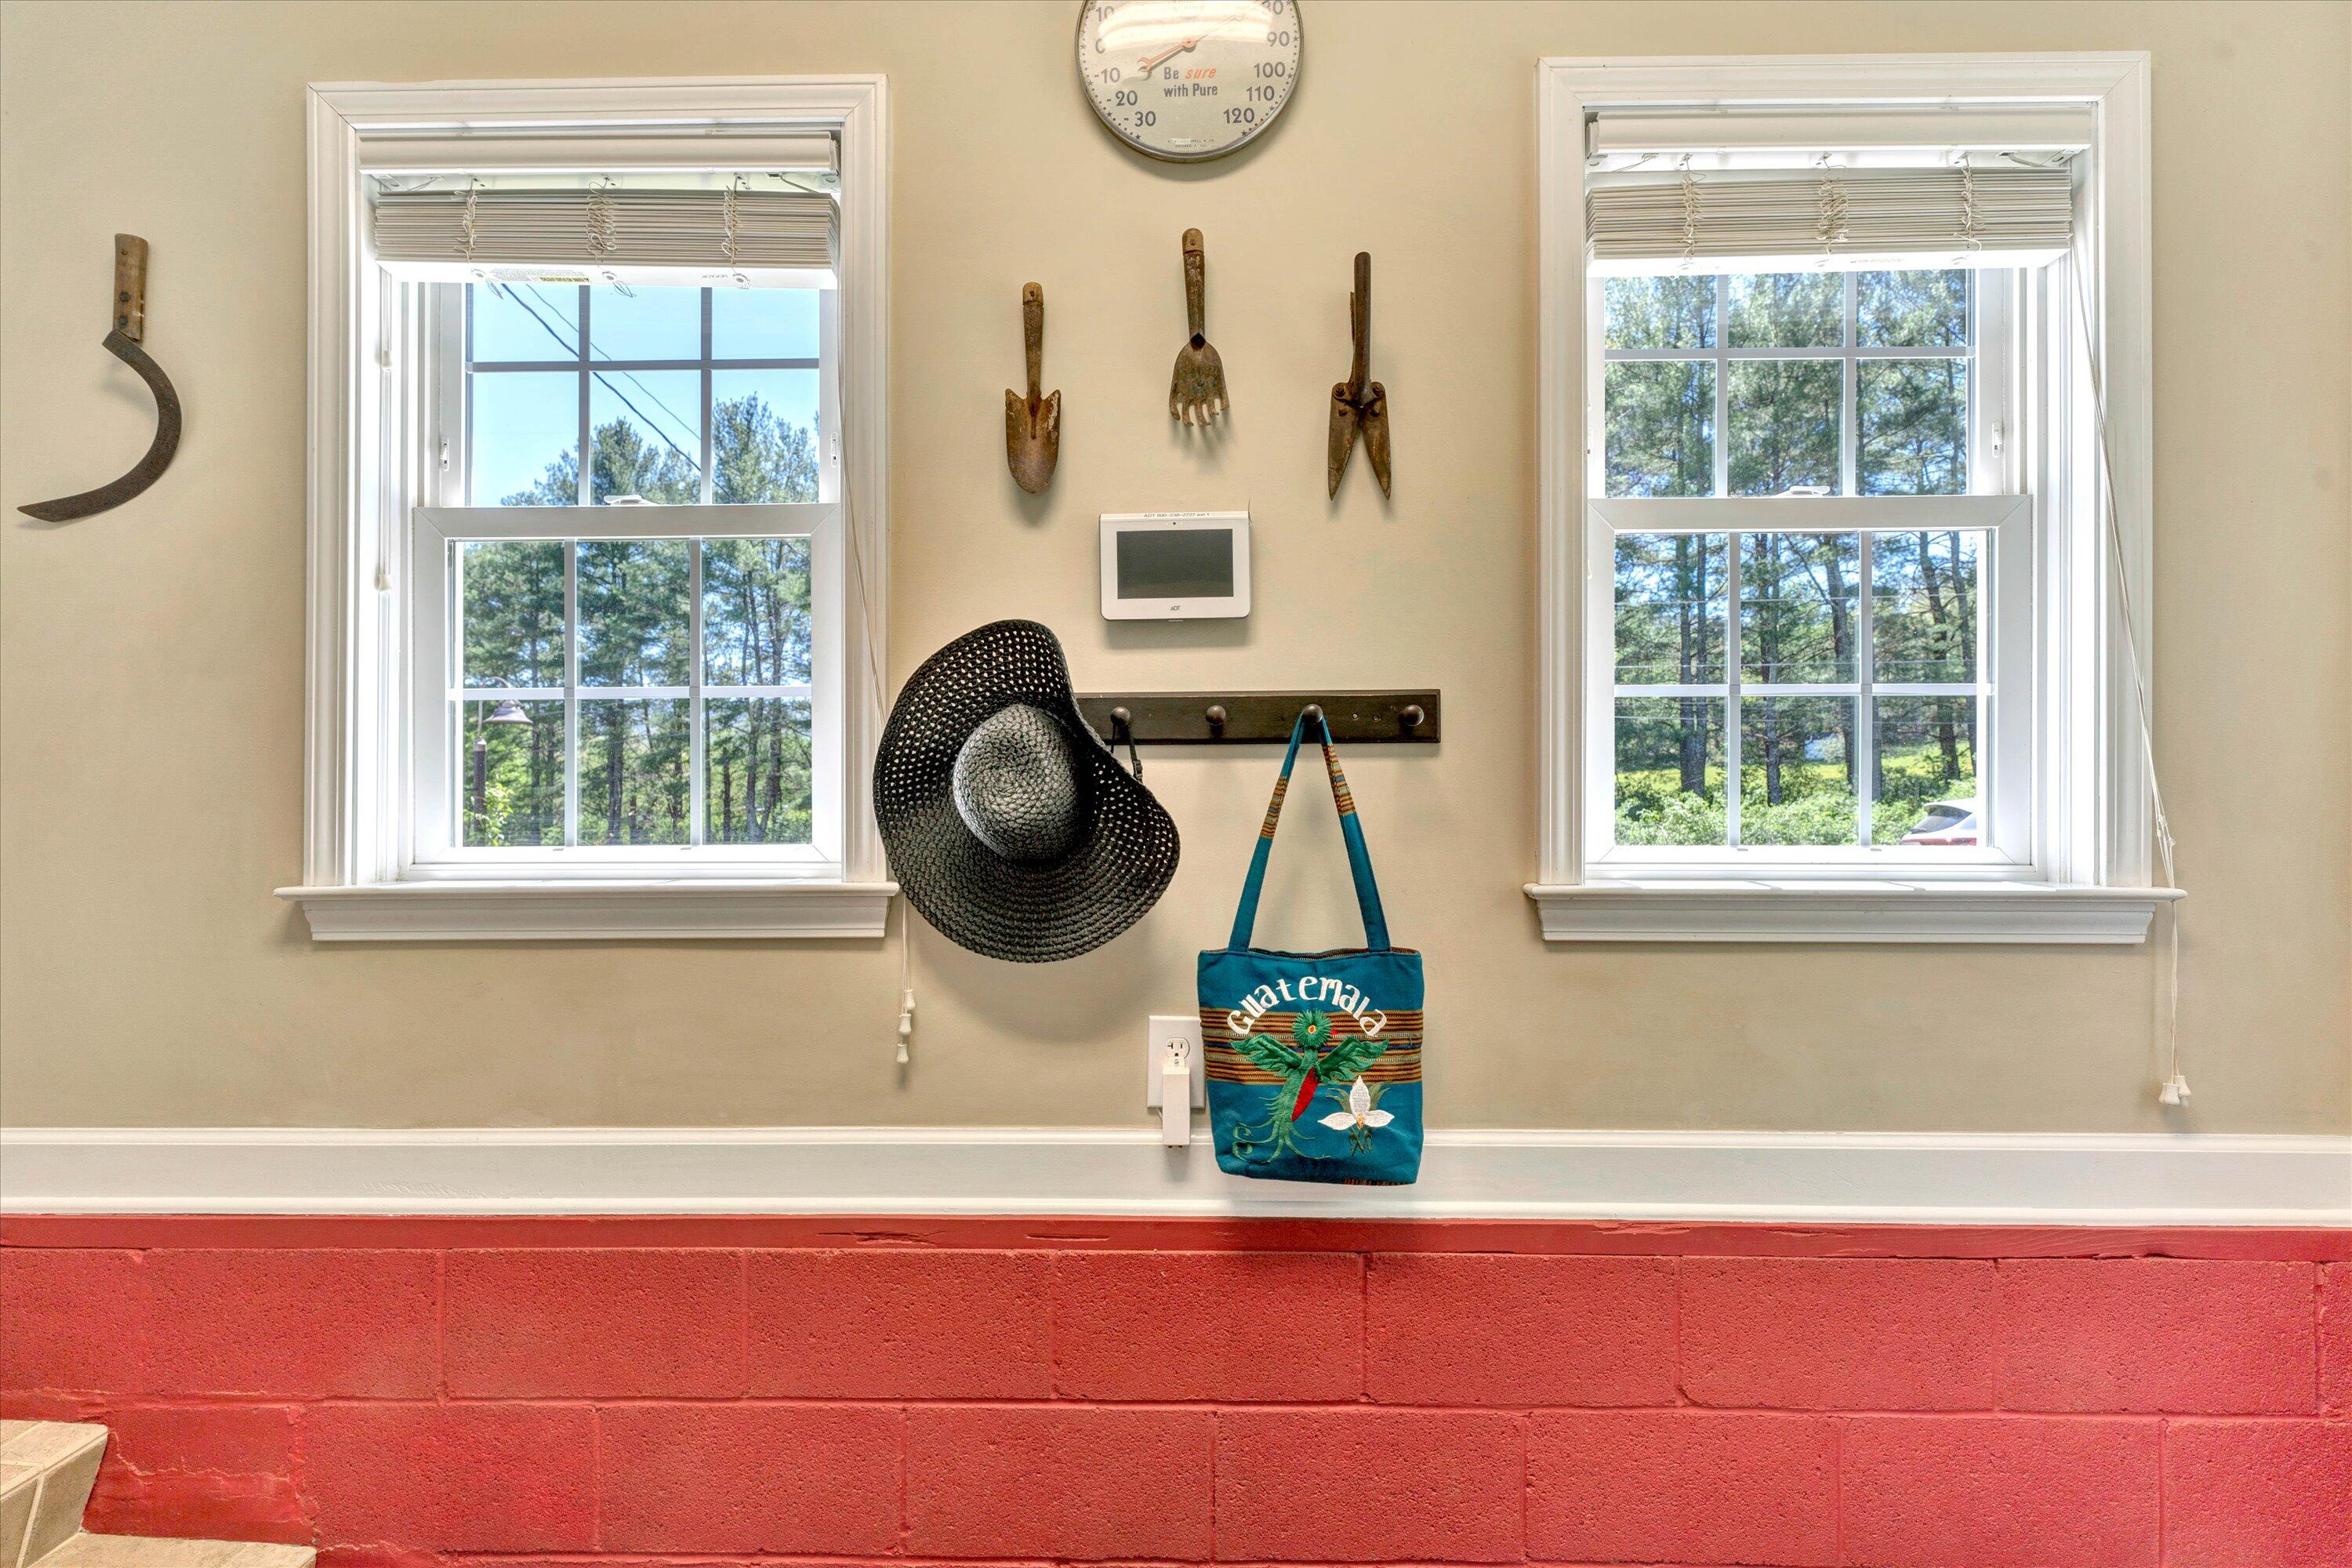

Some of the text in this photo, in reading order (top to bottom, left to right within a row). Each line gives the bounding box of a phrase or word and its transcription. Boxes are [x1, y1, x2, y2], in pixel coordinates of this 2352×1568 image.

[1267, 31, 1290, 47] 90
[1163, 67, 1217, 80] Be sure
[1254, 61, 1286, 78] 100
[1163, 82, 1218, 97] with Pure
[1247, 85, 1275, 102] 110
[1223, 107, 1255, 124] 120
[1226, 975, 1388, 1036] Guatemala
